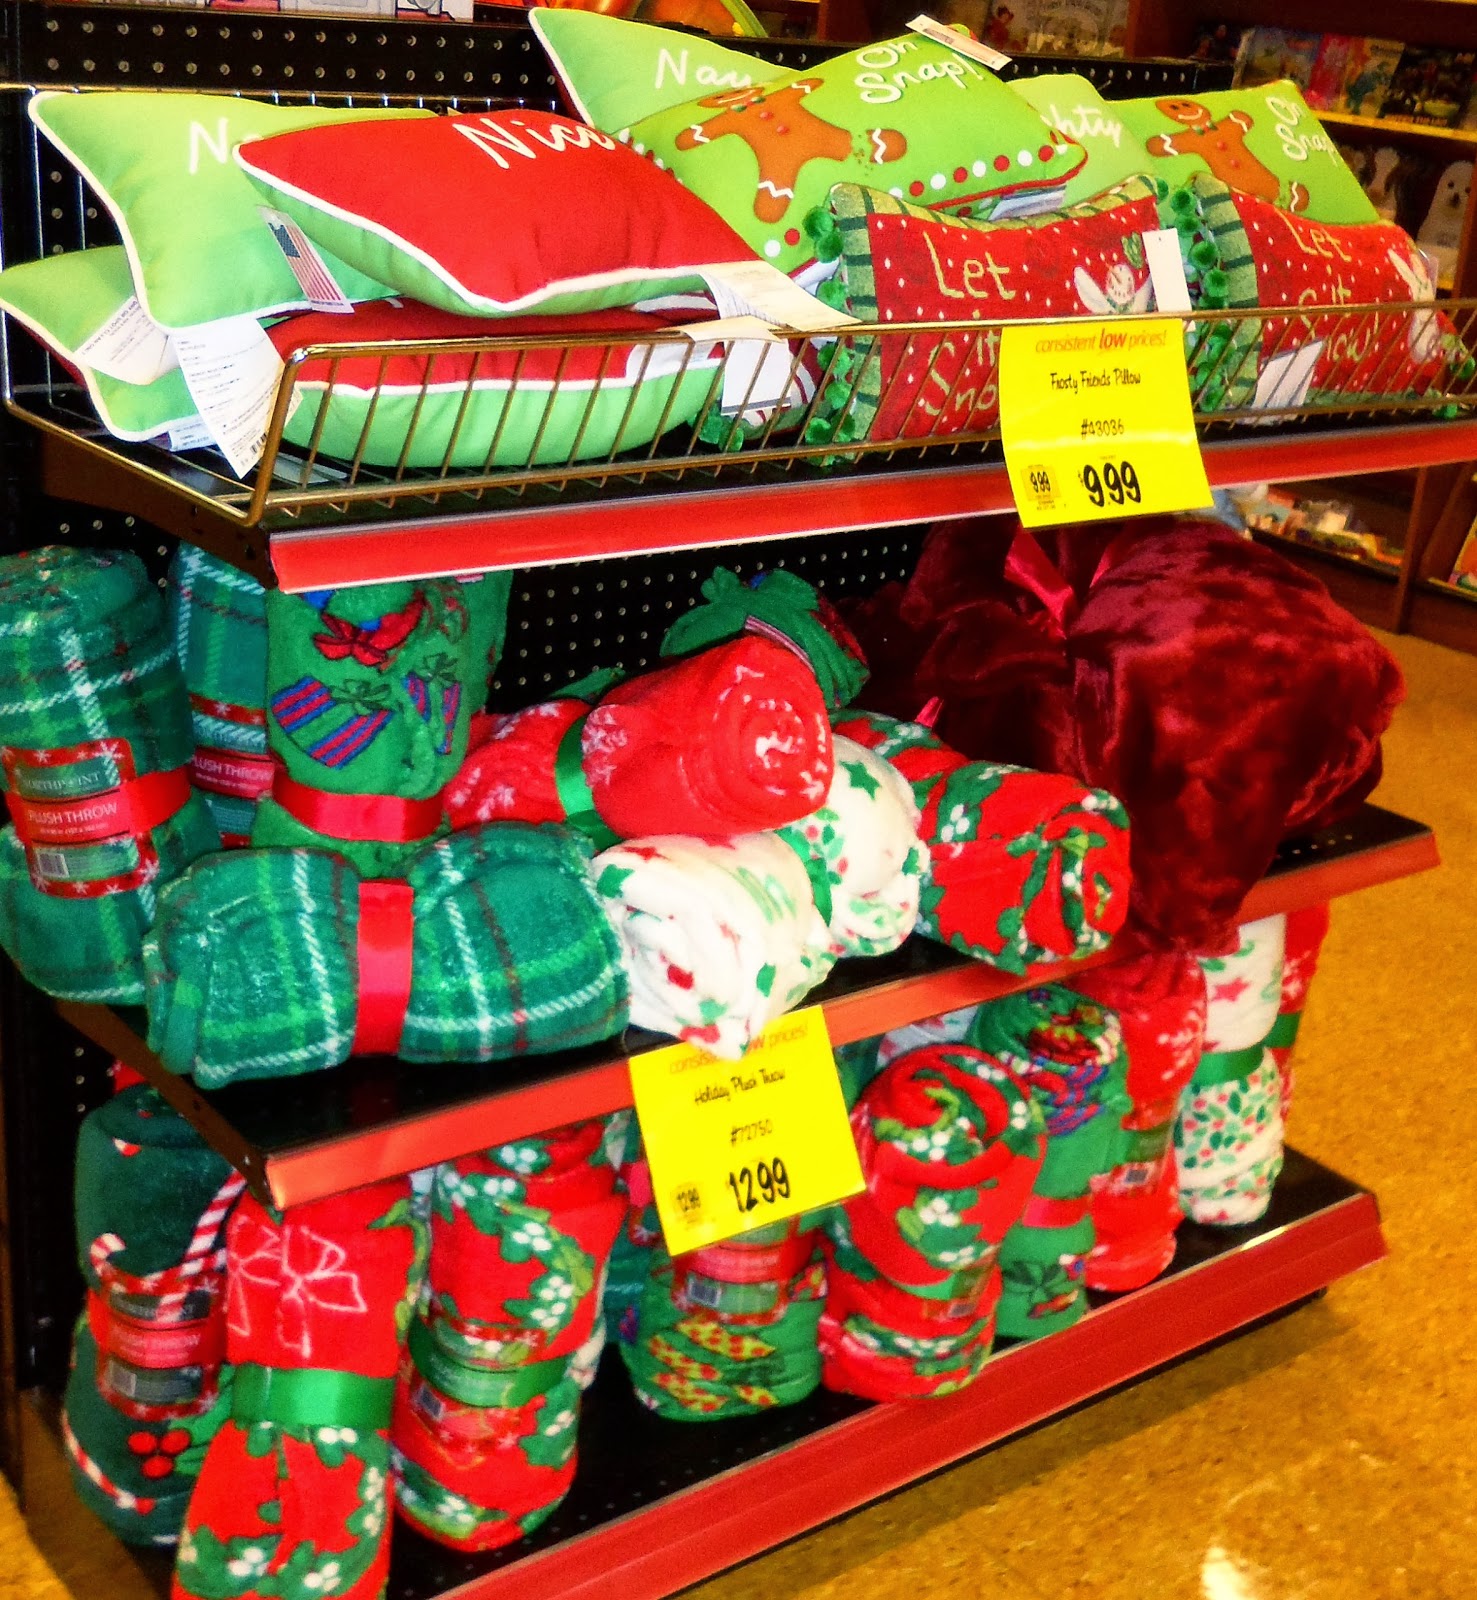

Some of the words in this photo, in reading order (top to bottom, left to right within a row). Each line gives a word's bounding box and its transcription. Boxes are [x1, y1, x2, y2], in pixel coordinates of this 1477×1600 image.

[655, 48, 752, 90] Nau
[854, 52, 985, 104] Snap!
[1040, 104, 1123, 148] hty
[1273, 206, 1352, 262] Let
[923, 231, 1016, 300] Let
[1035, 336, 1096, 353] consistent
[1099, 328, 1128, 350] low
[1128, 330, 1167, 351] prices!
[924, 342, 999, 416] Sno
[1050, 373, 1079, 394] Frosty
[1080, 369, 1111, 387] Friends
[1113, 368, 1141, 386] Pillow
[64, 802, 118, 823] THROW
